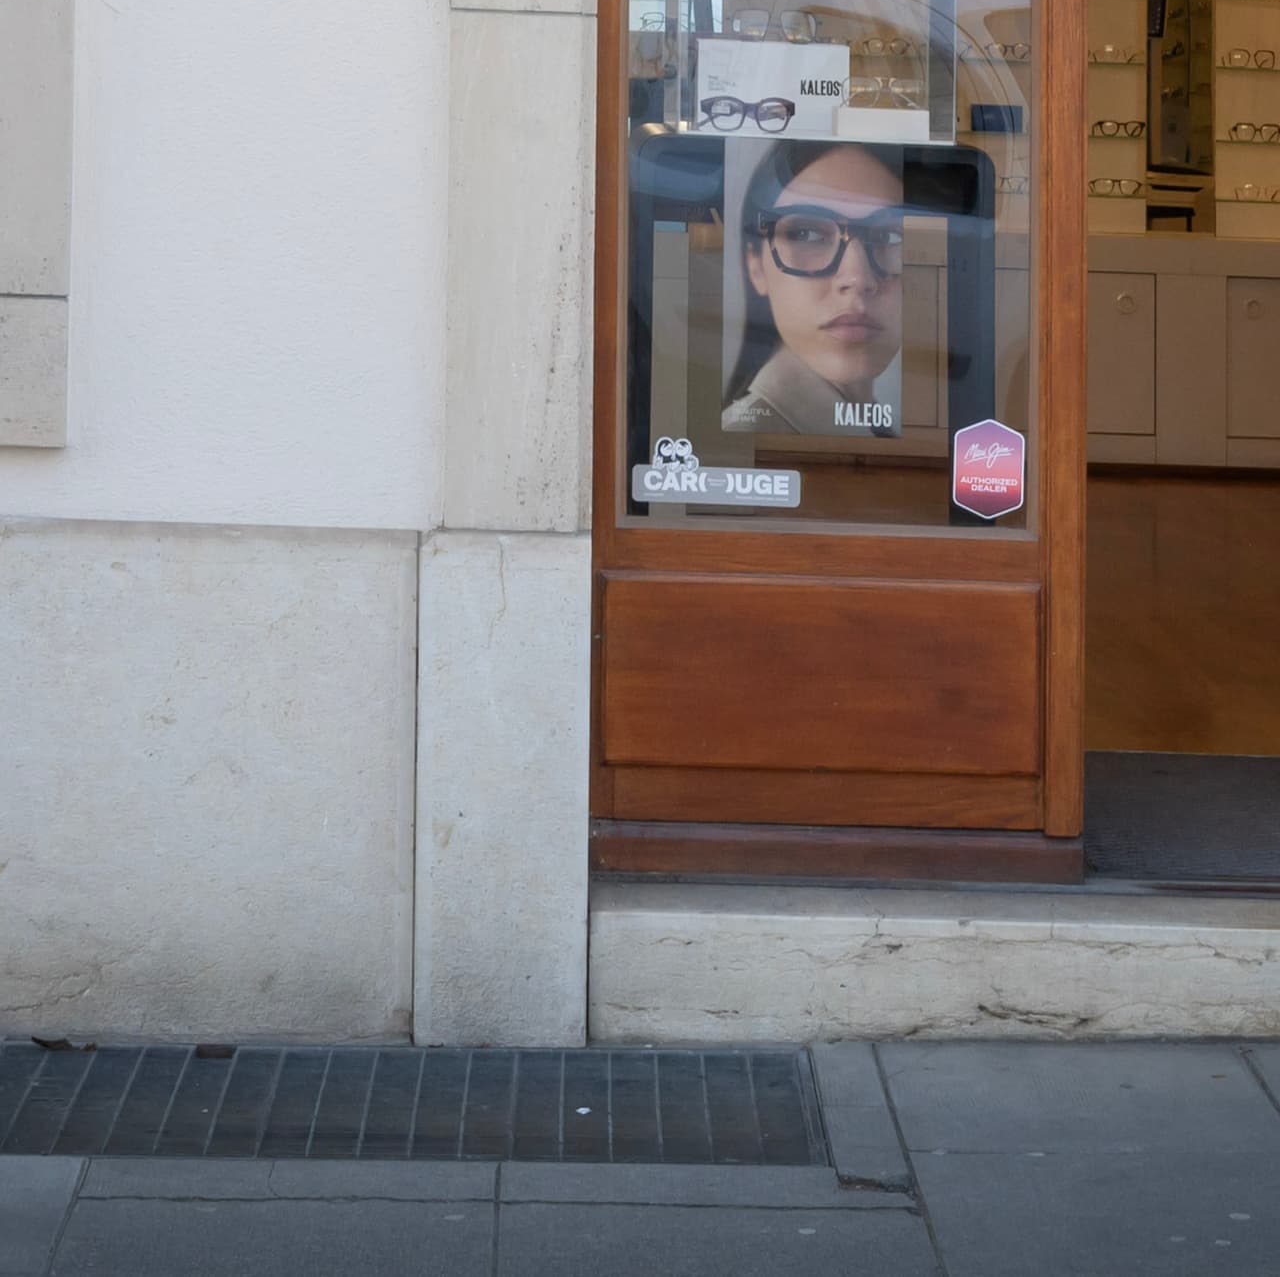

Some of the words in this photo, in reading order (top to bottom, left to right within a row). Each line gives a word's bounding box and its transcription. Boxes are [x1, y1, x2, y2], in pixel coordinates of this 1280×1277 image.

[800, 79, 840, 97] KALEOS
[834, 401, 893, 428] KALEOS
[960, 476, 1018, 486] AUTHORIZED
[971, 484, 1008, 494] DEALER
